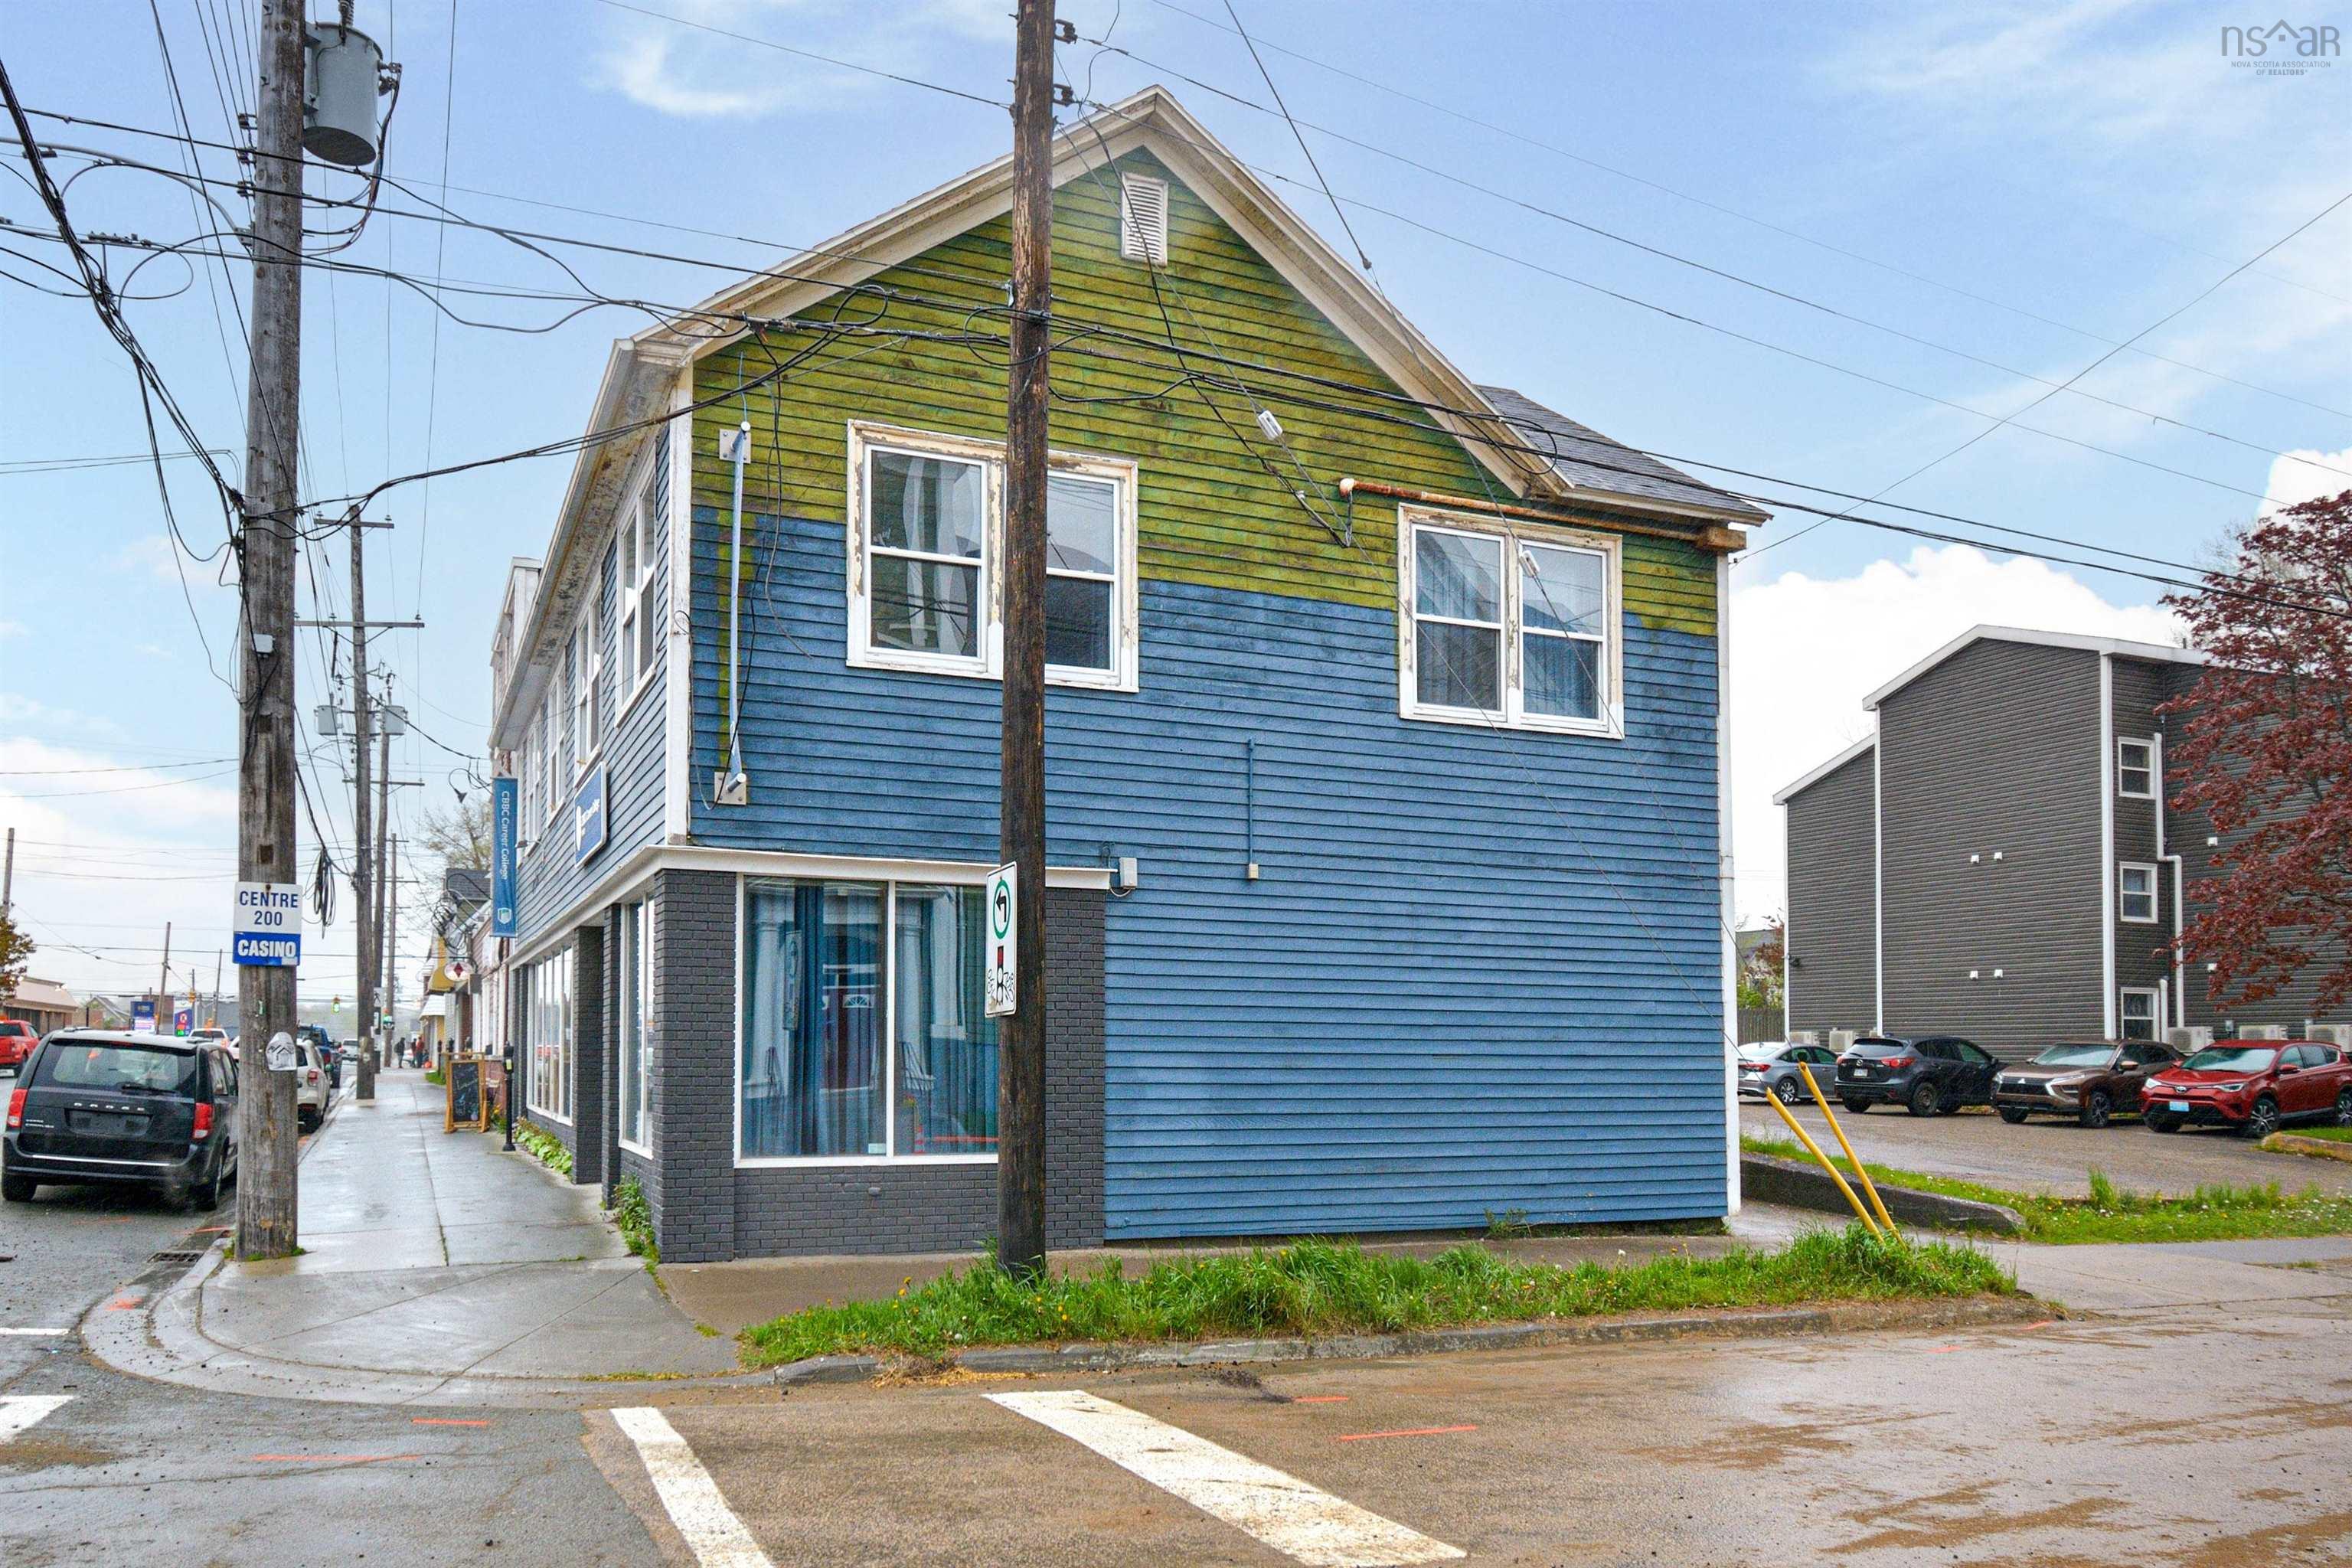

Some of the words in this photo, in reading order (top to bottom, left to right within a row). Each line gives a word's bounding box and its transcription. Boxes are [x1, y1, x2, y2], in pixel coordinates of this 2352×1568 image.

[501, 791, 510, 816] CBBC
[501, 818, 510, 848] Career
[499, 848, 510, 880] College
[240, 890, 299, 908] CENTRE
[253, 910, 283, 926] 200
[237, 939, 296, 958] CASINO
